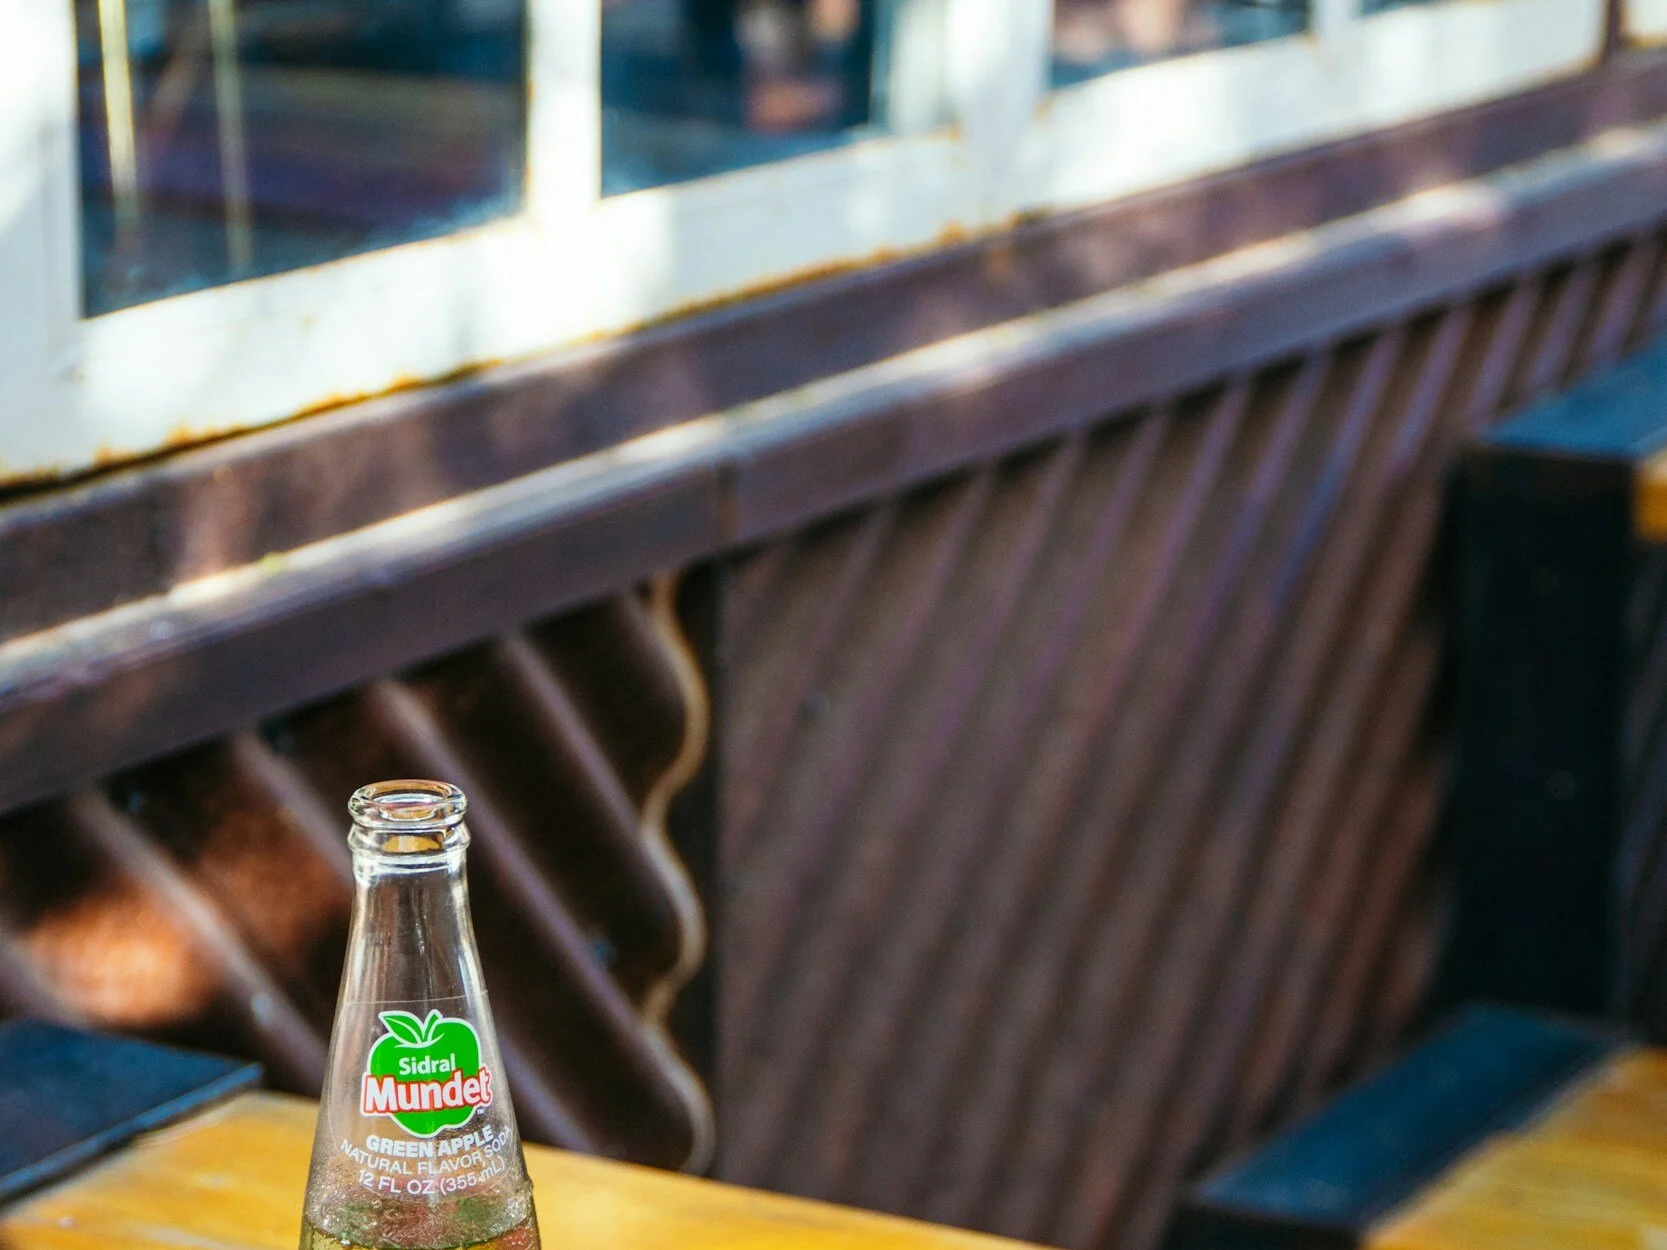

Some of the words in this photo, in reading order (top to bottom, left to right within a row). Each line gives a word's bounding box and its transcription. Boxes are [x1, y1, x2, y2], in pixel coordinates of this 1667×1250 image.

[399, 1053, 455, 1075] Sidral
[364, 1068, 491, 1113] Mundet
[341, 1140, 412, 1175] NATURAL
[418, 1151, 483, 1175] FLAVOR
[484, 1126, 511, 1157] SODA
[366, 1135, 435, 1158] GREEN
[437, 1125, 494, 1157] APPLE
[359, 1169, 374, 1187] 12
[378, 1177, 401, 1194] FL
[407, 1180, 435, 1195] OZ
[439, 1175, 477, 1196] (355
[481, 1154, 506, 1181] mL)
